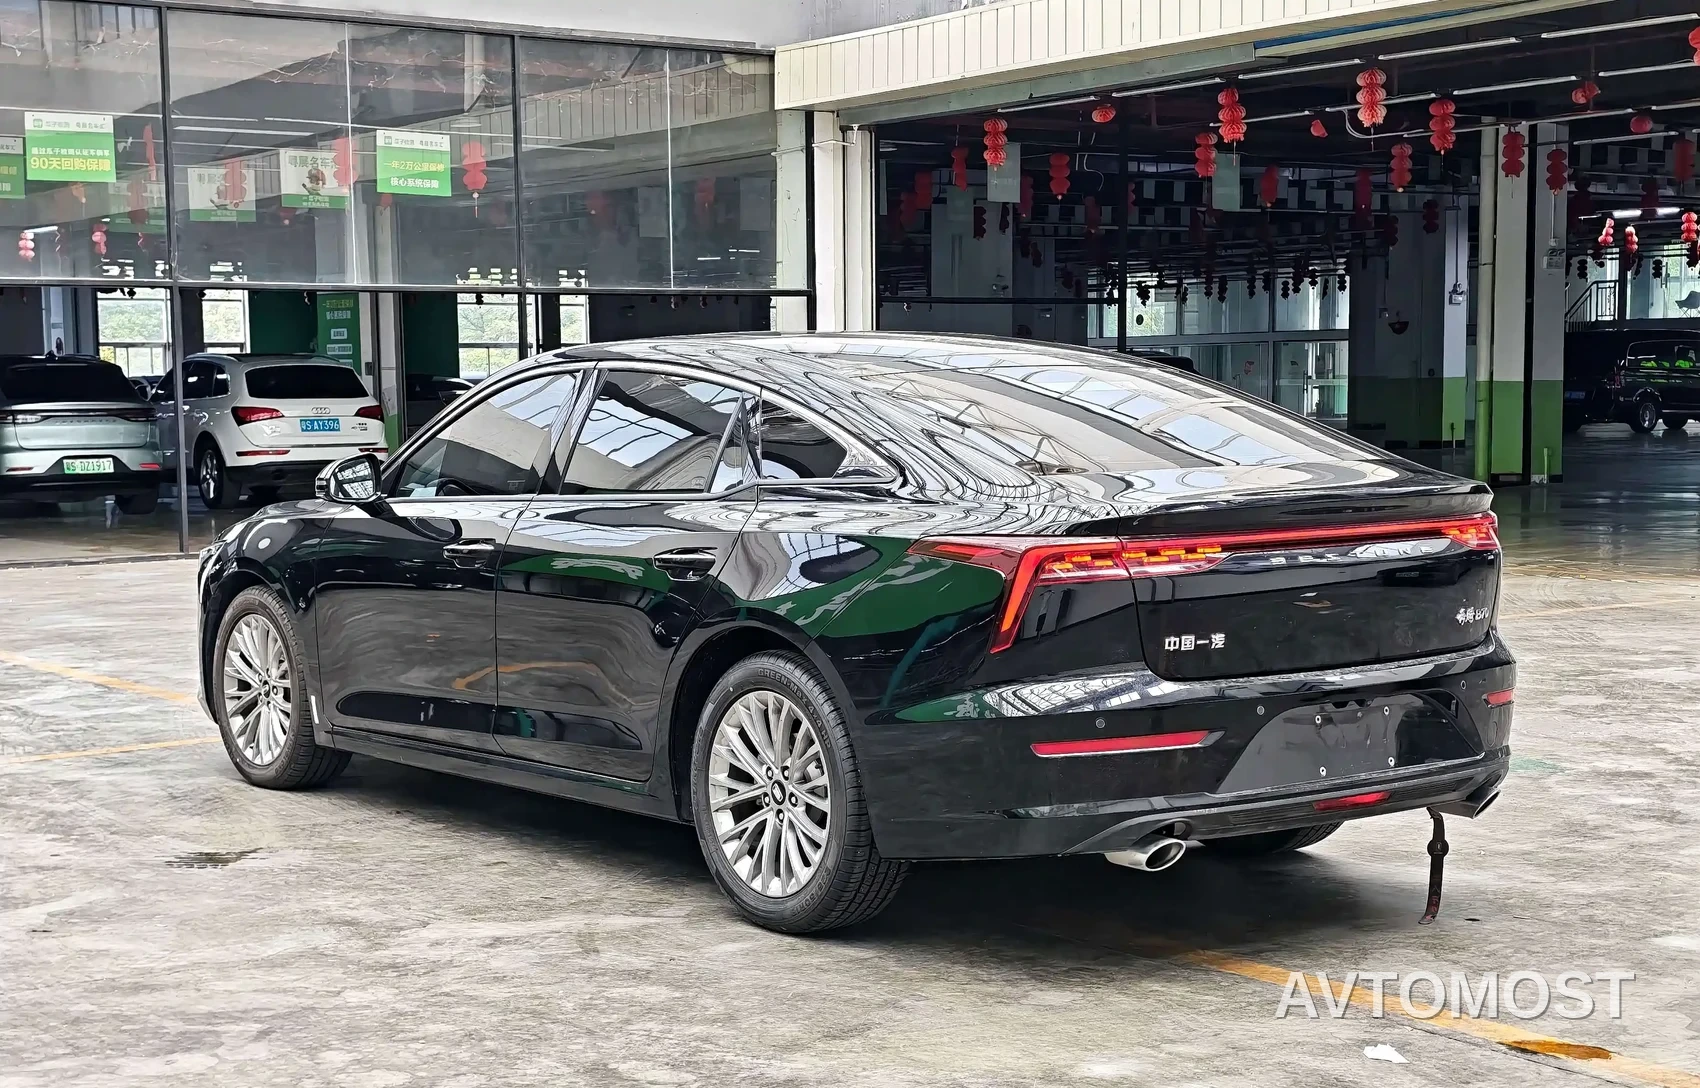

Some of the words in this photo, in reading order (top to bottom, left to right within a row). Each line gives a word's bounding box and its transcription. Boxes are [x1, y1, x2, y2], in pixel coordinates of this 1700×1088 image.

[30, 156, 112, 172] 90天回购保障
[383, 160, 445, 173] 一年2万公里保修
[390, 176, 439, 189] 核心系统保障
[1164, 632, 1226, 652] 中国一汽
